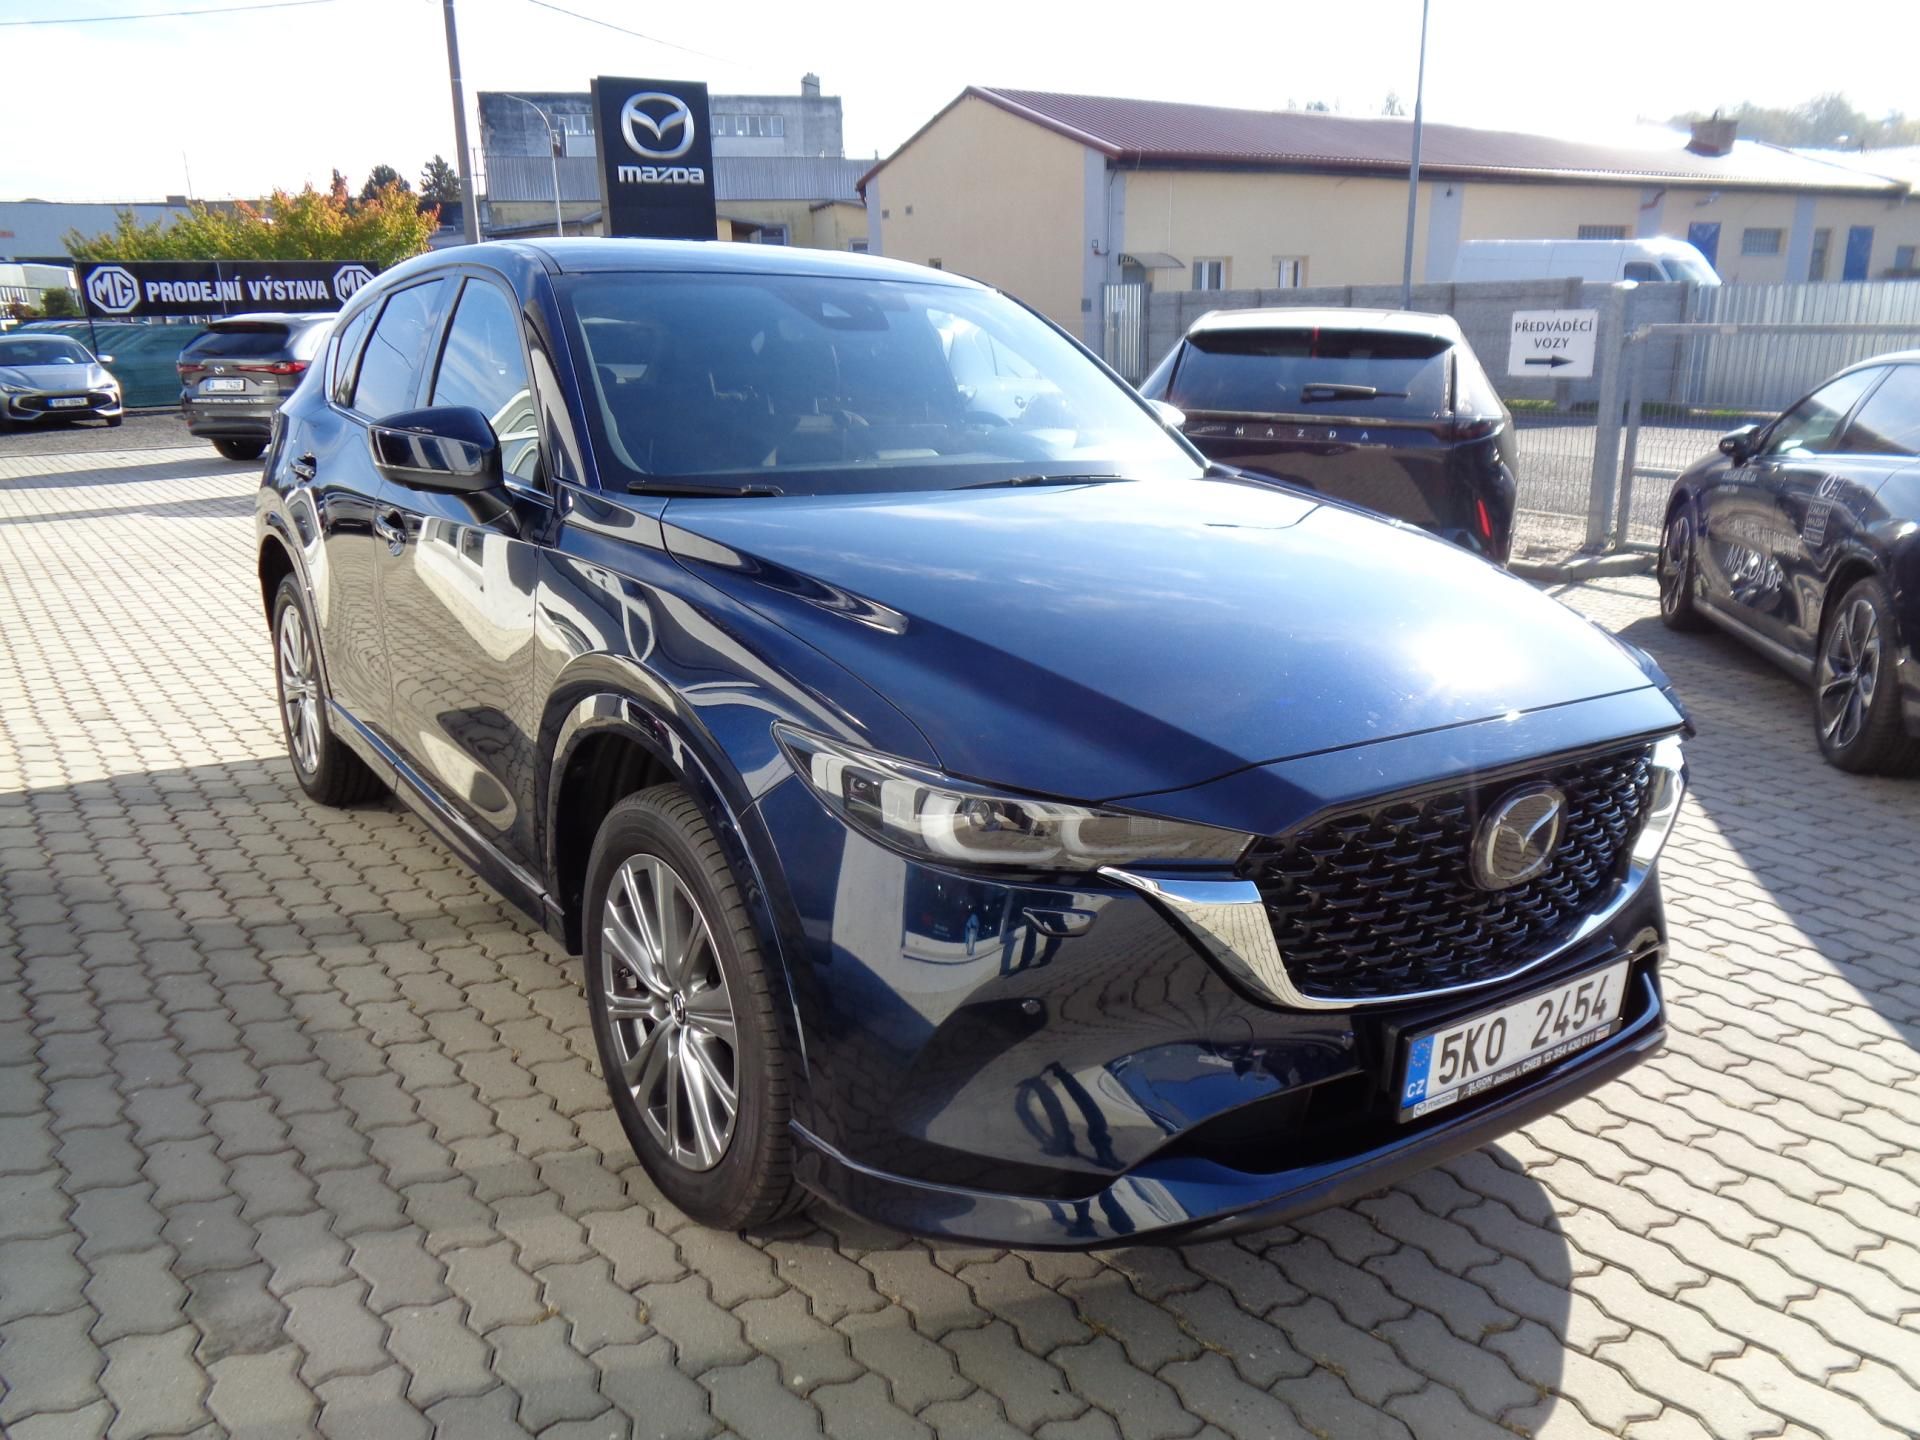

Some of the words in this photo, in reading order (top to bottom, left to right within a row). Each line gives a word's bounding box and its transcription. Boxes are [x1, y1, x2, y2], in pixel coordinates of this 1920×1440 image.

[618, 165, 704, 184] mazda
[91, 270, 136, 310] MG
[145, 276, 243, 303] PRODEJNÍ
[247, 273, 329, 301] VÝSTAVA
[1514, 318, 1593, 332] PŘEDVÁDĚCÍ
[1534, 337, 1570, 349] VOZY
[1235, 427, 1369, 440] MAZDA
[1531, 975, 1608, 1050] 2454
[1407, 1079, 1425, 1099] CZ
